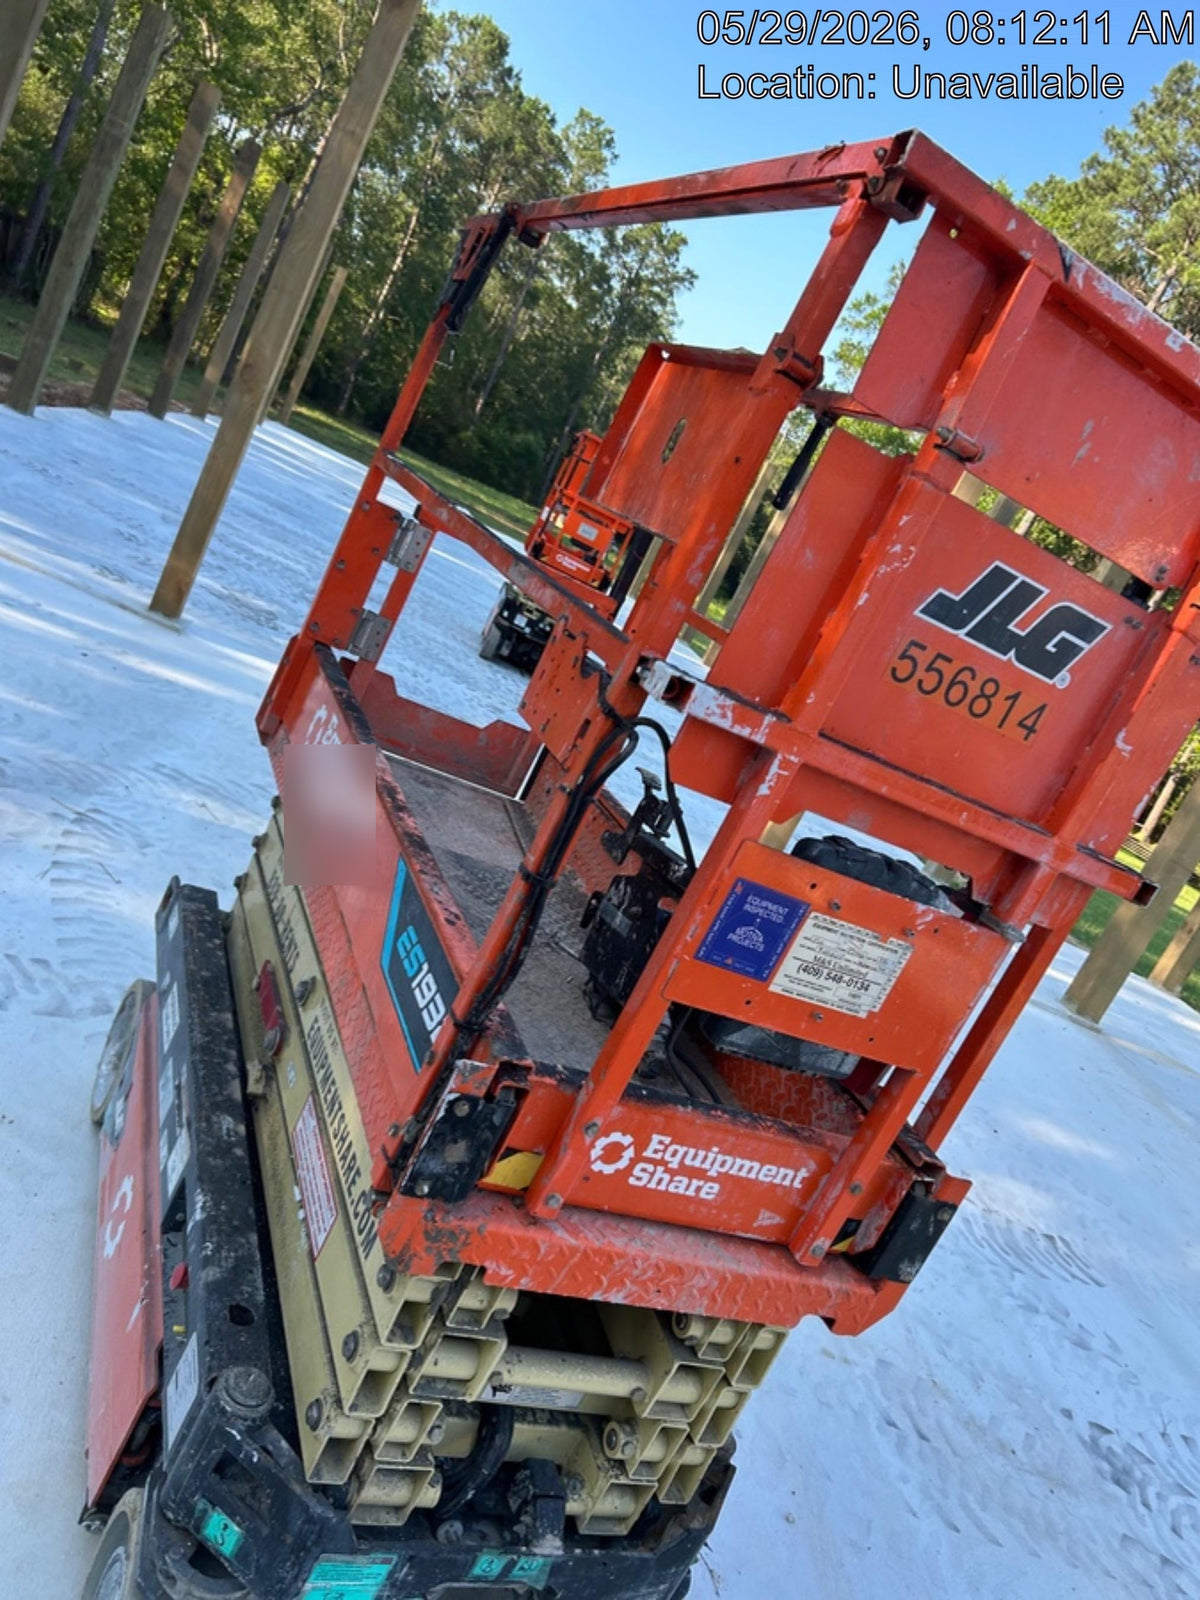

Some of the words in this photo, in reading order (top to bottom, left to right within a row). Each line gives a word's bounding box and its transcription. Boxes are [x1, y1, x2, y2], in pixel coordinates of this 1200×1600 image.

[913, 560, 1114, 685] JLG
[890, 639, 1048, 742] 556814
[743, 903, 784, 923] INSPECTED
[746, 895, 789, 916] EQUIPMENT
[797, 963, 824, 981] (409)
[824, 971, 871, 992] 548-0134
[642, 1133, 809, 1189] Equipment
[628, 1162, 721, 1200] Share
